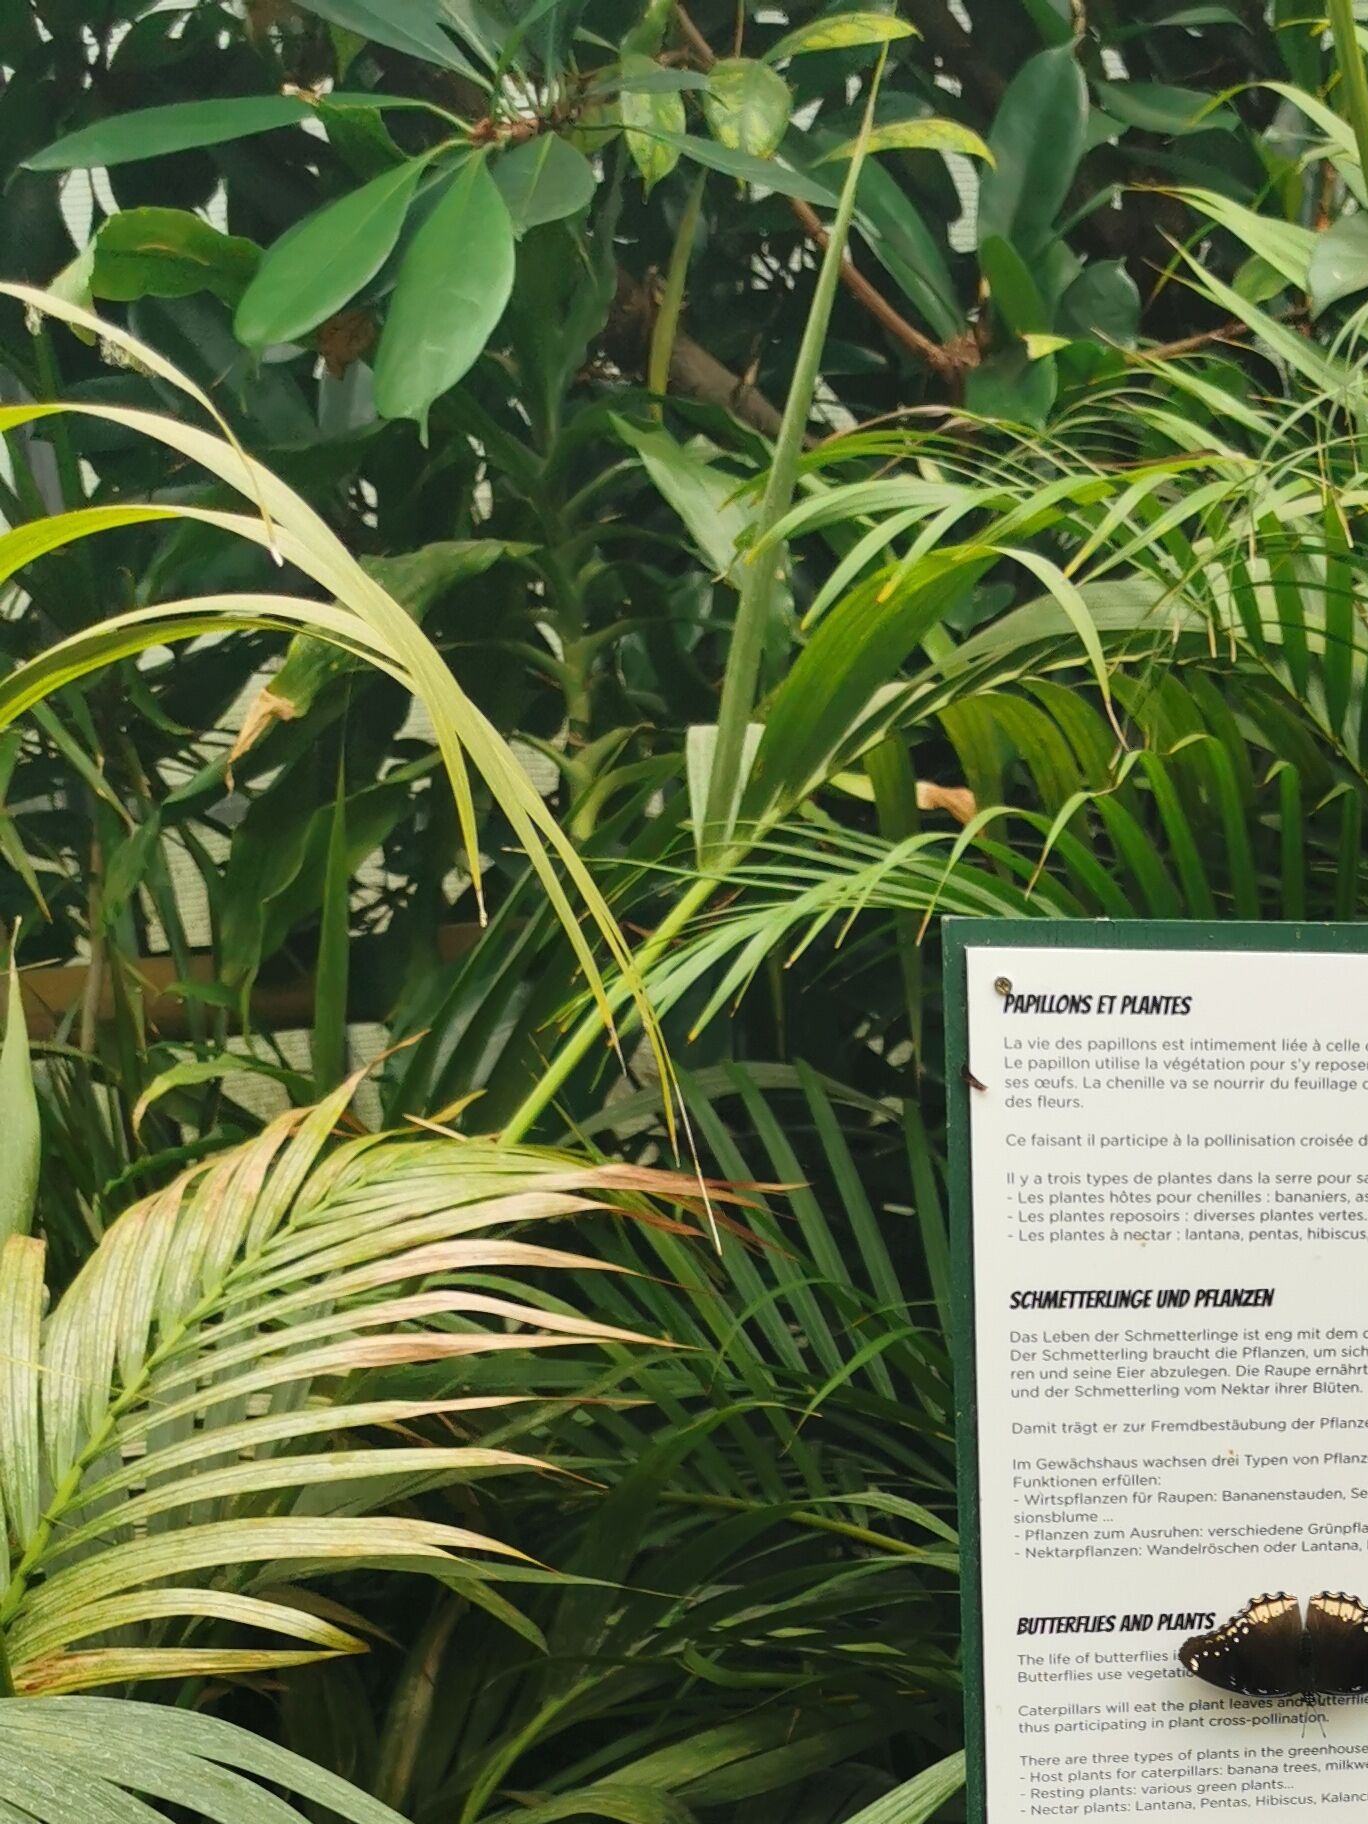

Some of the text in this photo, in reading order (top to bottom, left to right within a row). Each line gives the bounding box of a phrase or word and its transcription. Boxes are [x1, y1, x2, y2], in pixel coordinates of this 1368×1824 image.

[1003, 994, 1193, 1016] PAPILLONS ET PLANTES
[1003, 1036, 1023, 1050] La
[1027, 1036, 1050, 1050] vie
[1054, 1036, 1083, 1050] des
[1087, 1036, 1157, 1053] papillons
[1161, 1037, 1185, 1051] est
[1189, 1037, 1277, 1052] intimement
[1281, 1037, 1308, 1052] liée
[1312, 1038, 1321, 1052] à
[1325, 1037, 1360, 1053] celle
[1004, 1055, 1023, 1069] Le
[1027, 1055, 1090, 1072] papillon
[1094, 1055, 1141, 1070] utilise
[1144, 1055, 1158, 1070] la
[1162, 1056, 1245, 1073] végétation
[1249, 1059, 1286, 1073] pour
[1290, 1057, 1311, 1073] s'y
[1004, 1094, 1084, 1109] des fleurs.
[1005, 1133, 1027, 1147] Ce
[1030, 1132, 1082, 1147] faisant
[1086, 1133, 1095, 1147] il
[1100, 1133, 1169, 1149] participe
[1172, 1132, 1182, 1147] à
[1186, 1133, 1200, 1147] la
[1204, 1133, 1296, 1149] pollinisation
[1299, 1133, 1354, 1147] croisée
[1008, 1287, 1275, 1310] SCHMETTERLINGE UND PFLANZEN
[1009, 1330, 1038, 1344] Das
[1042, 1329, 1090, 1344] Leben
[1094, 1328, 1120, 1343] der
[1124, 1327, 1239, 1344] Schmetterlinge
[1242, 1327, 1260, 1341] ist
[1264, 1329, 1293, 1343] eng
[1296, 1327, 1321, 1340] mit
[1324, 1327, 1358, 1340] dem
[1010, 1381, 1363, 1399] und der Schmetterling vom Nektar ihrer Blüten.
[1011, 1421, 1057, 1435] Damit
[1061, 1421, 1098, 1436] trägt
[1102, 1423, 1118, 1433] er
[1122, 1422, 1146, 1433] zur
[1150, 1418, 1287, 1433] Fremdbestäubung
[1290, 1417, 1316, 1430] der
[1012, 1458, 1031, 1470] Im
[1035, 1456, 1138, 1471] Gewächshaus
[1142, 1455, 1207, 1469] wachsen
[1212, 1454, 1239, 1467] drei
[1243, 1453, 1288, 1469] Typen
[1292, 1455, 1319, 1466] von
[1012, 1473, 1161, 1489] Funktionen erfüllen:
[1024, 1528, 1089, 1541] Pflanzen
[1092, 1529, 1125, 1540] zum
[1128, 1525, 1203, 1539] Ausruhen:
[1207, 1523, 1304, 1537] verschiedene
[1024, 1544, 1142, 1560] Nektarpflanzen:
[1146, 1541, 1260, 1556] Wandelröschen
[1262, 1540, 1297, 1553] oder
[1300, 1539, 1362, 1553] Lantana,
[1016, 1612, 1216, 1635] BUTTERFLIES AND PLANTS
[1016, 1653, 1045, 1666] The
[1048, 1652, 1071, 1665] life
[1074, 1651, 1091, 1664] of
[1094, 1649, 1169, 1664] butterflies
[1016, 1669, 1093, 1683] Butterflies
[1096, 1670, 1123, 1681] use
[1017, 1703, 1101, 1718] Caterpillars
[1104, 1701, 1130, 1714] will
[1133, 1701, 1158, 1713] eat
[1160, 1699, 1185, 1712] the
[1188, 1698, 1225, 1713] plant
[1229, 1697, 1273, 1709] leaves
[1018, 1711, 1330, 1734] thus participating in plant cross-pollination.
[1030, 1771, 1064, 1783] Host
[1067, 1769, 1112, 1783] plants
[1116, 1767, 1137, 1780] for
[1140, 1763, 1223, 1779] caterpillars:
[1226, 1763, 1279, 1776] banana
[1282, 1762, 1321, 1773] trees,
[1030, 1804, 1080, 1816] Nectar
[1083, 1801, 1131, 1816] plants:
[1134, 1799, 1196, 1811] Lantana,
[1200, 1797, 1251, 1809] Pentas,
[1255, 1794, 1317, 1806] Hibiscus,
